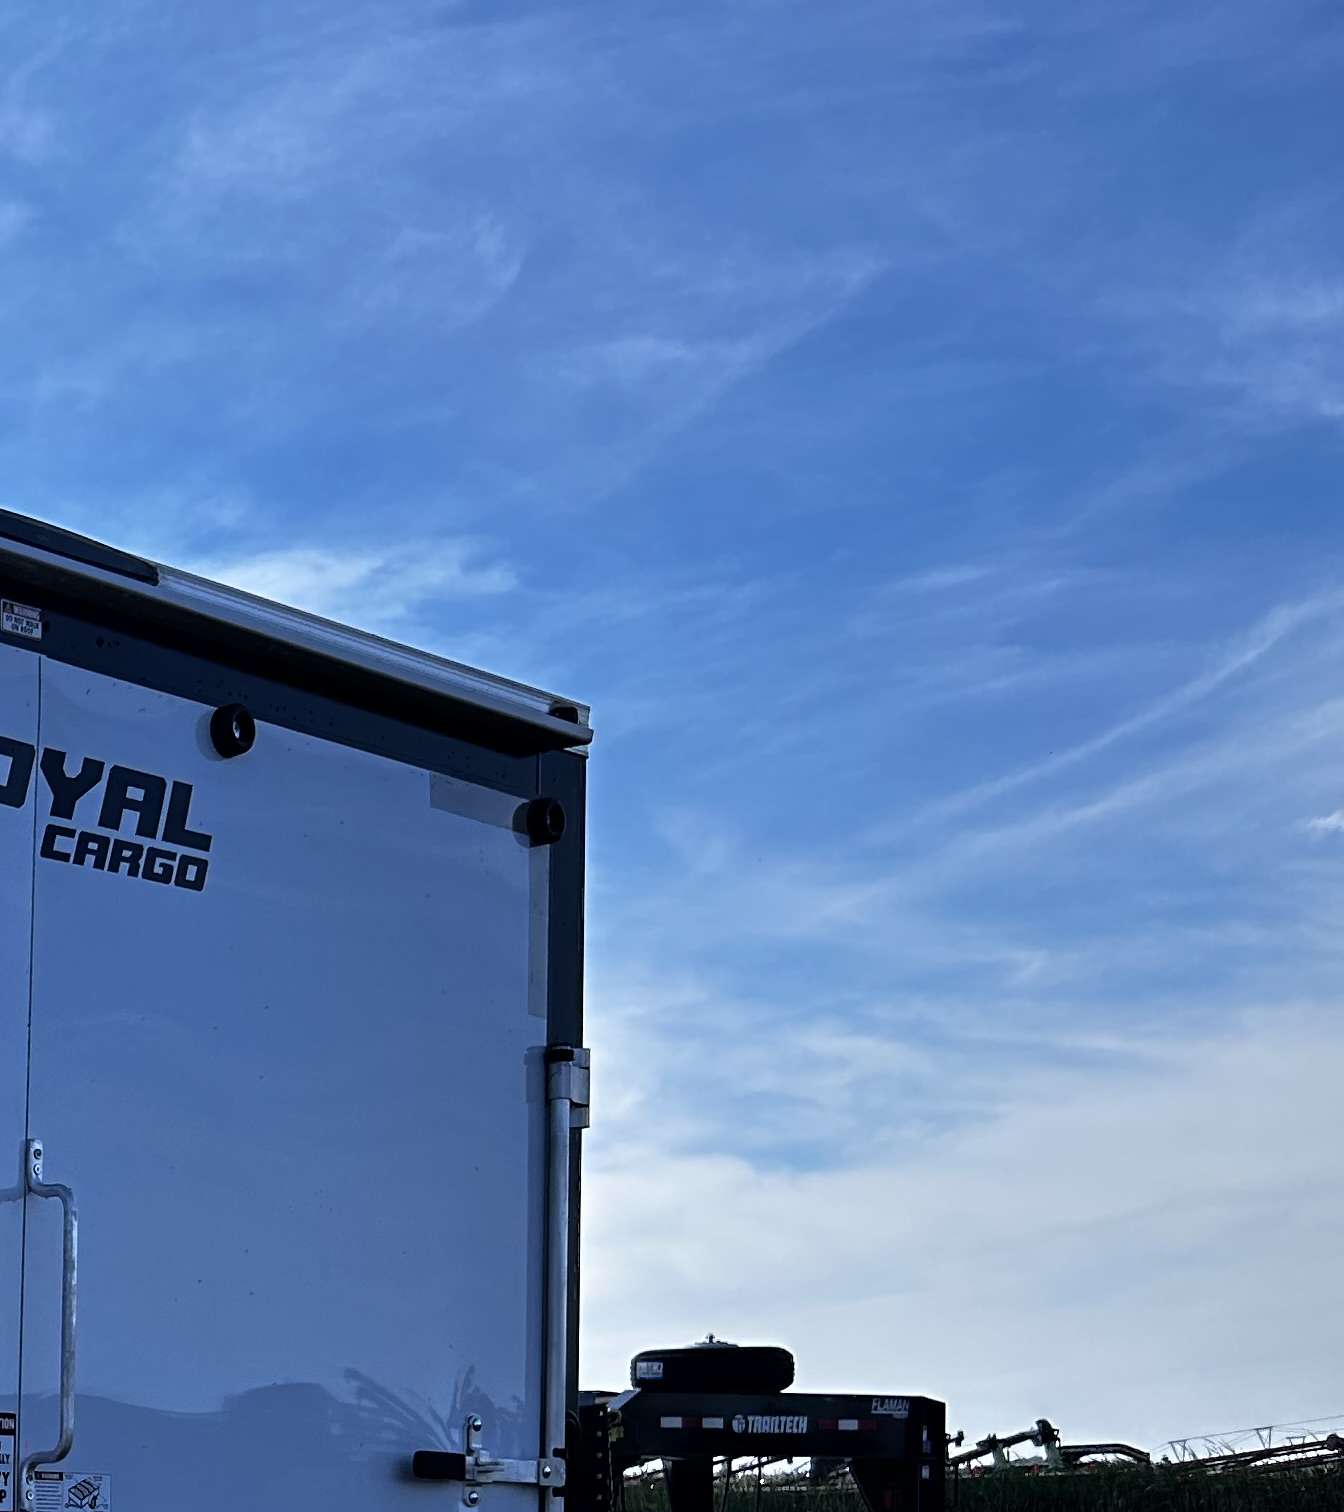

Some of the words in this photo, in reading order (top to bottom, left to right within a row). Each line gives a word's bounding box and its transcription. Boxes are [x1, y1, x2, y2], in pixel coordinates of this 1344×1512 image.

[40, 824, 209, 892] CARGO
[871, 1398, 910, 1411] FLAMAN
[747, 1415, 808, 1434] TRAILTECH
